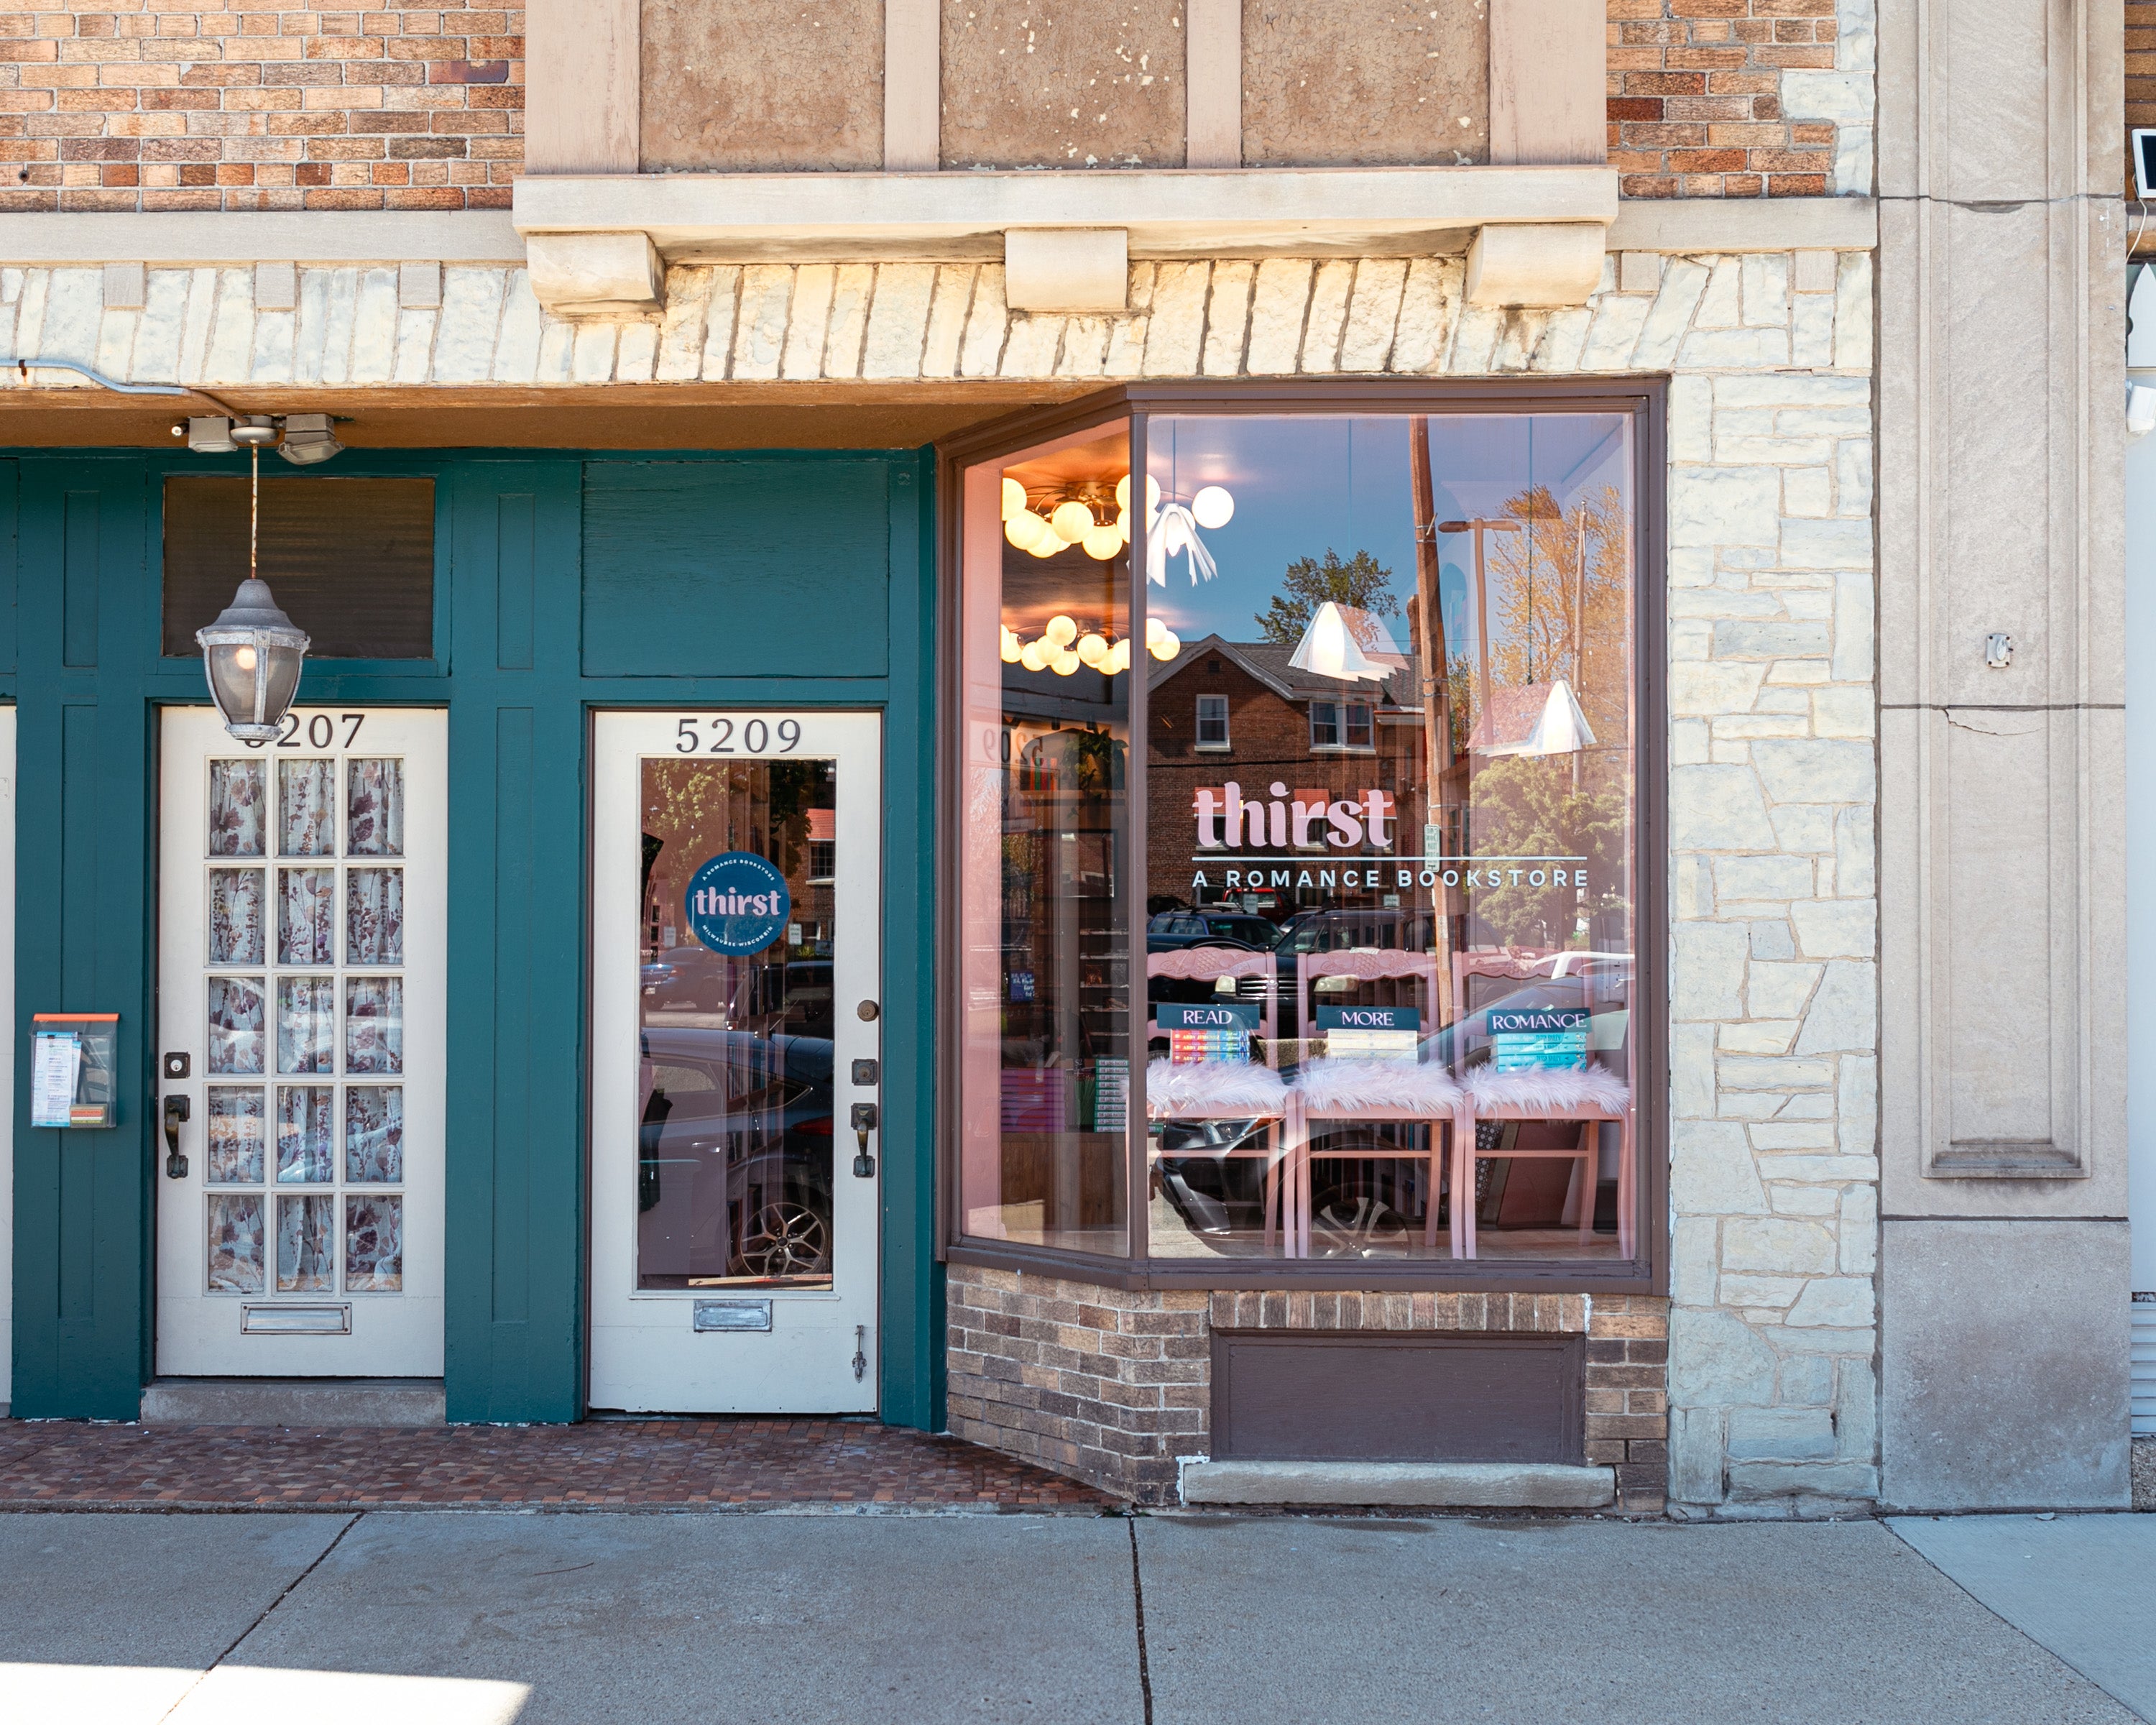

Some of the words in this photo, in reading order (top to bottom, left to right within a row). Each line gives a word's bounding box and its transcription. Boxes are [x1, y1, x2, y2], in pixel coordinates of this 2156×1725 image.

[244, 713, 365, 748] 207
[676, 718, 801, 753] 5209
[1192, 781, 1394, 848] thirst
[706, 859, 737, 876] ROMANCE
[740, 859, 775, 881] BOOKSTORE
[1192, 870, 1208, 887] A
[1227, 870, 1380, 887] ROMANCE
[1398, 870, 1588, 887] BOOKSTORE
[694, 886, 782, 916] thirst
[701, 924, 736, 947] MILWAUKEE
[738, 926, 774, 947] WISCONSIN
[1183, 1010, 1233, 1025] READ
[1342, 1011, 1395, 1026] MORE
[1492, 1013, 1587, 1030] ROMANCE
